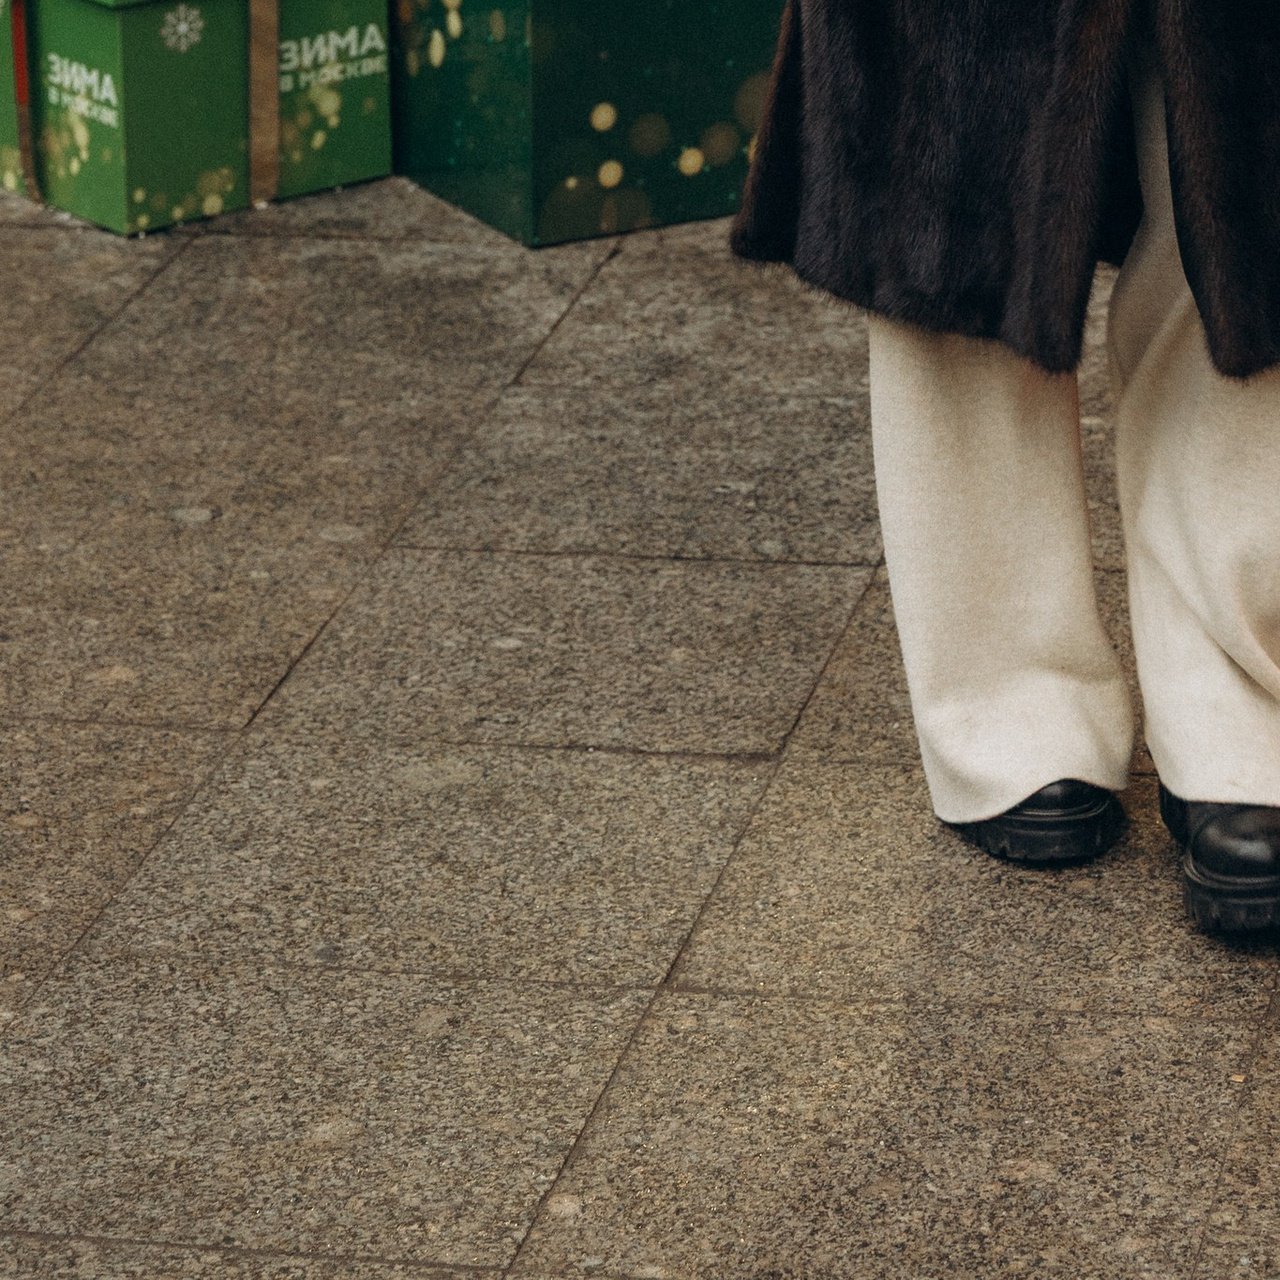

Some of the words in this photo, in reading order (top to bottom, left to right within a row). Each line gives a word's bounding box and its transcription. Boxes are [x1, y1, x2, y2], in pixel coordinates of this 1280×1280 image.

[278, 23, 387, 72] ЗИМА
[47, 85, 60, 106] В
[48, 52, 119, 108] ЗИМА
[279, 73, 295, 93] В
